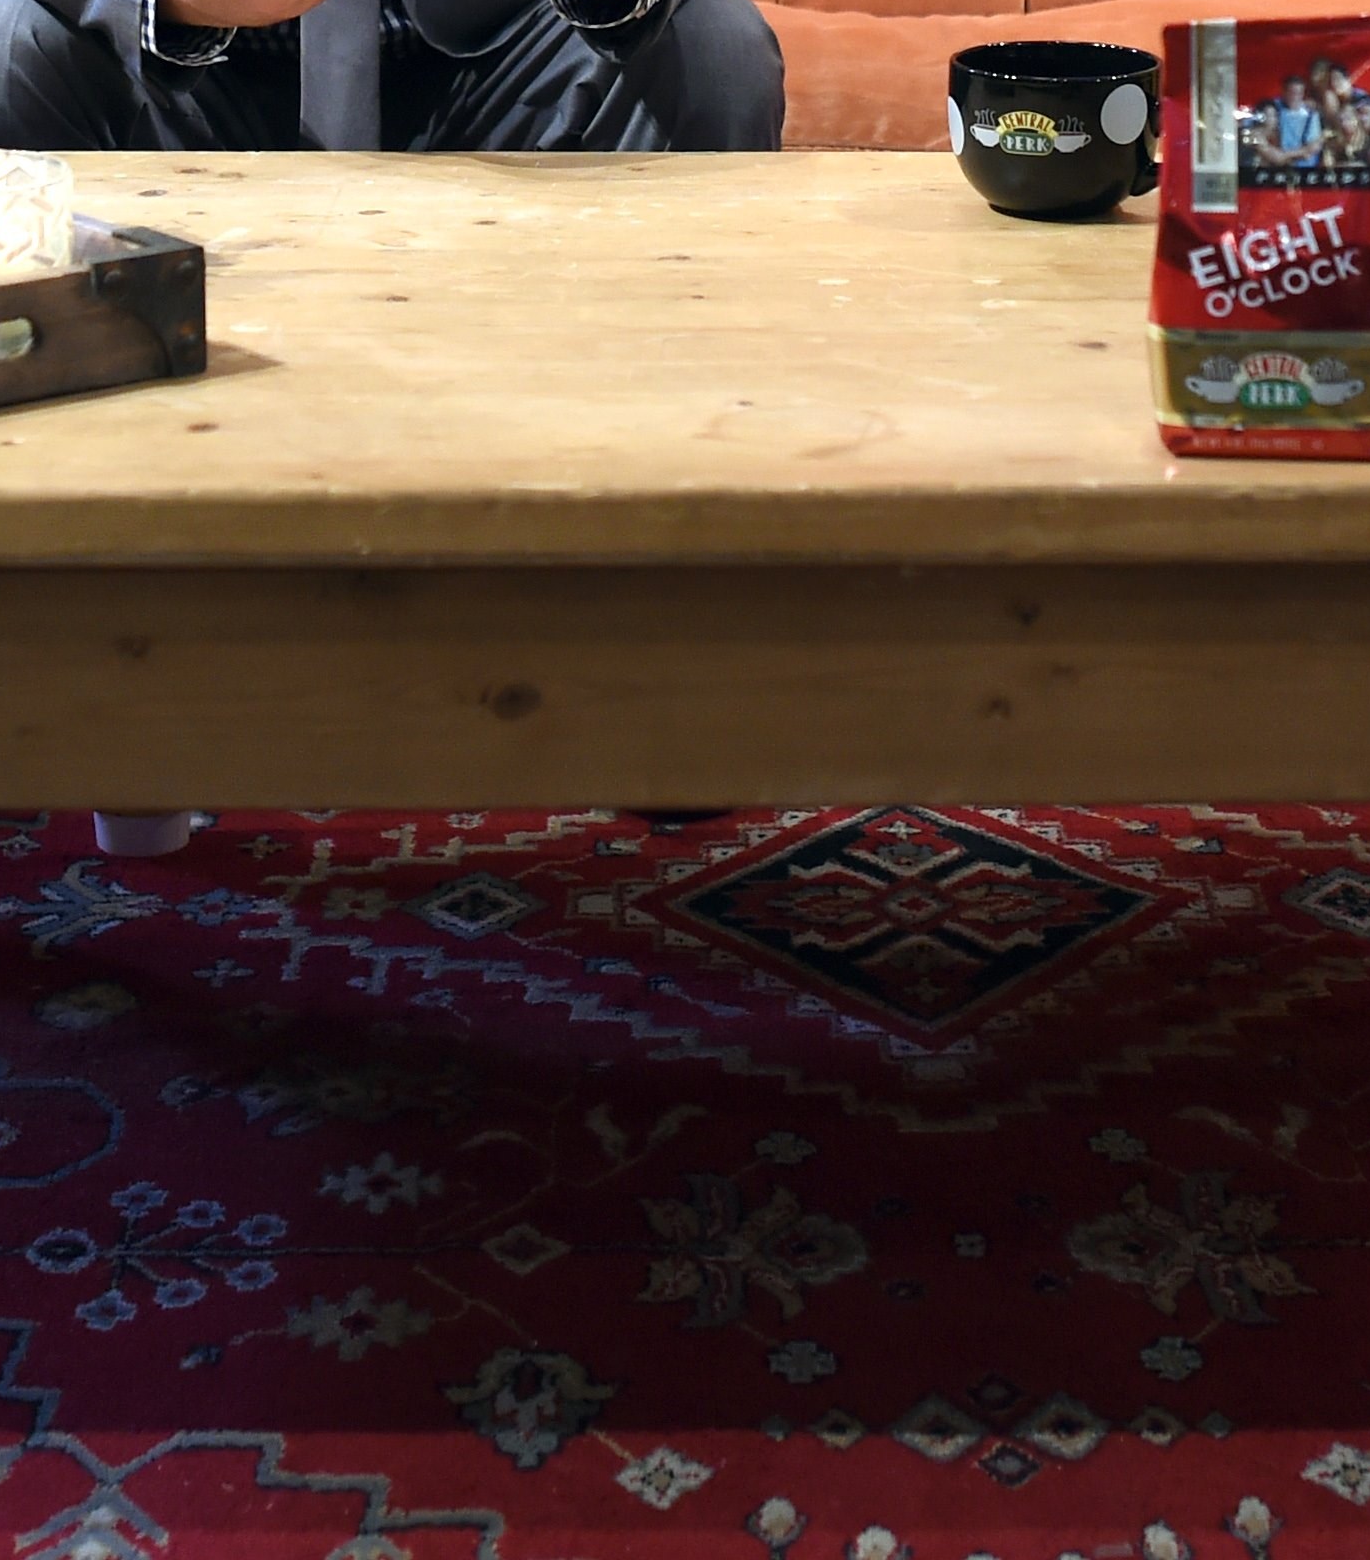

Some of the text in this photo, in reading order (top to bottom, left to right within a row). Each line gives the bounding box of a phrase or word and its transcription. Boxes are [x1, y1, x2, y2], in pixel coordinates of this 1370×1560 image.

[1002, 112, 1051, 132] CENTRAL
[1005, 134, 1048, 152] PERK
[1188, 204, 1345, 289] EIGHT
[1204, 247, 1363, 318] O'CLOCK
